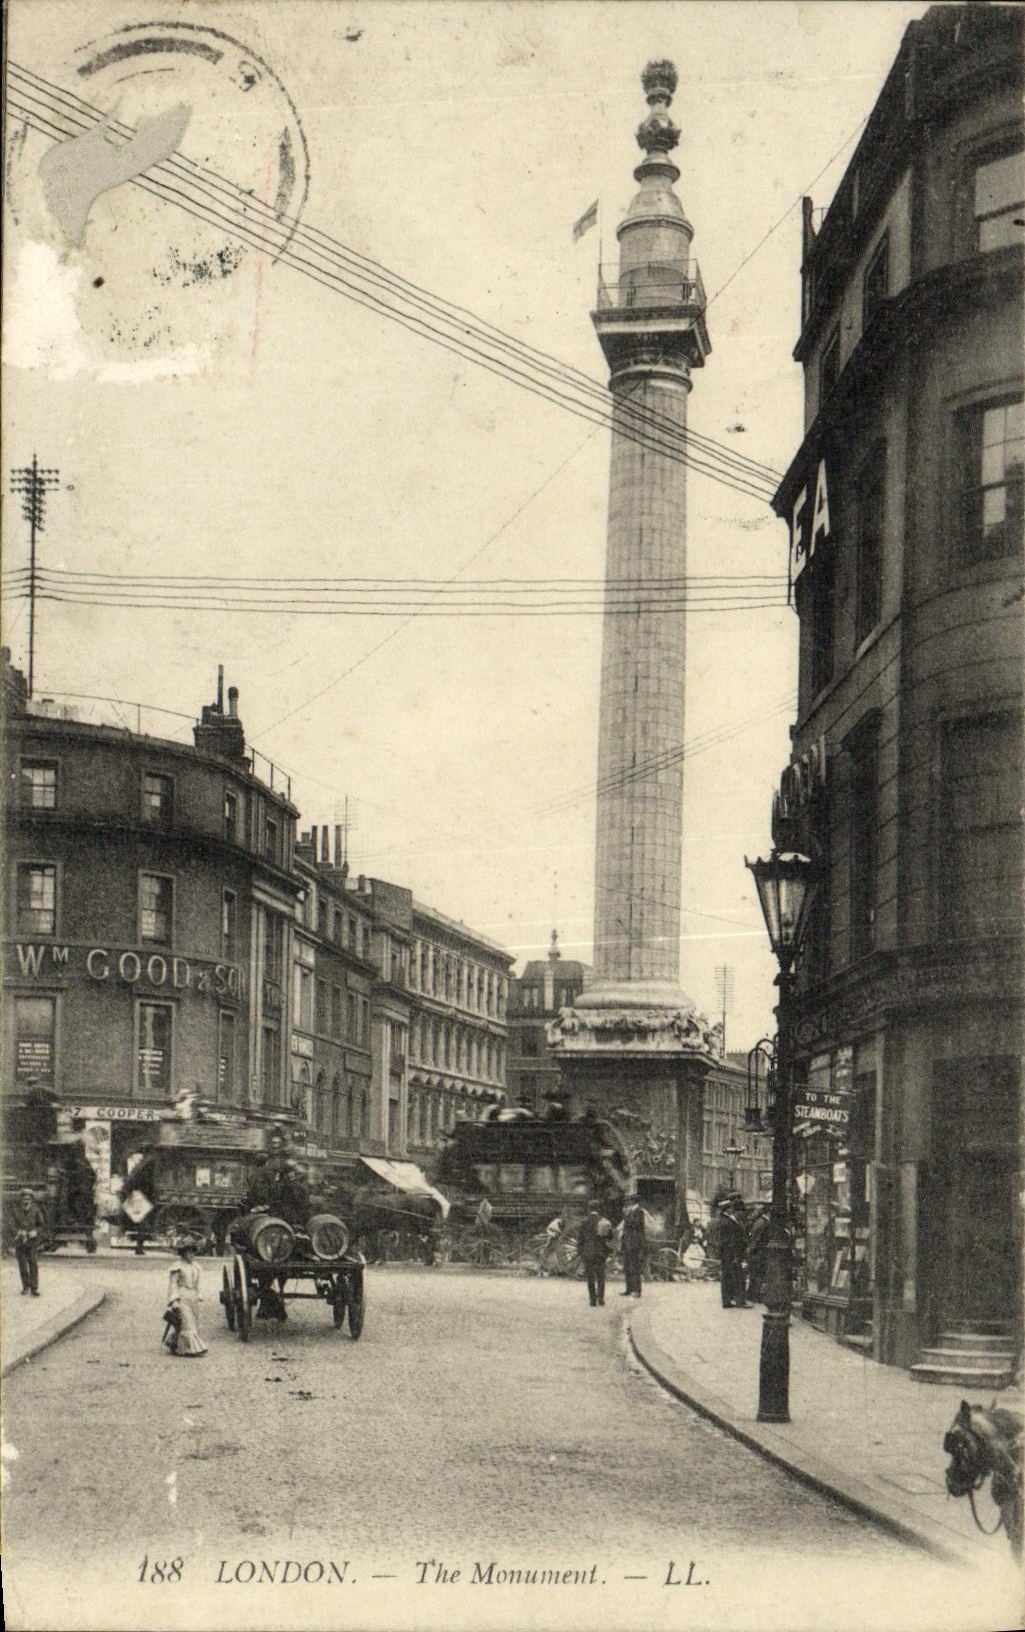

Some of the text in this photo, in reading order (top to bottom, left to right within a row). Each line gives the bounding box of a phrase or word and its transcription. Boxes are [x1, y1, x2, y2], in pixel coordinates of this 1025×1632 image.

[86, 948, 190, 989] GOOD
[805, 1092, 842, 1105] TO THE
[96, 1107, 155, 1121] COOPER
[794, 1104, 850, 1123] STEAMBOATS
